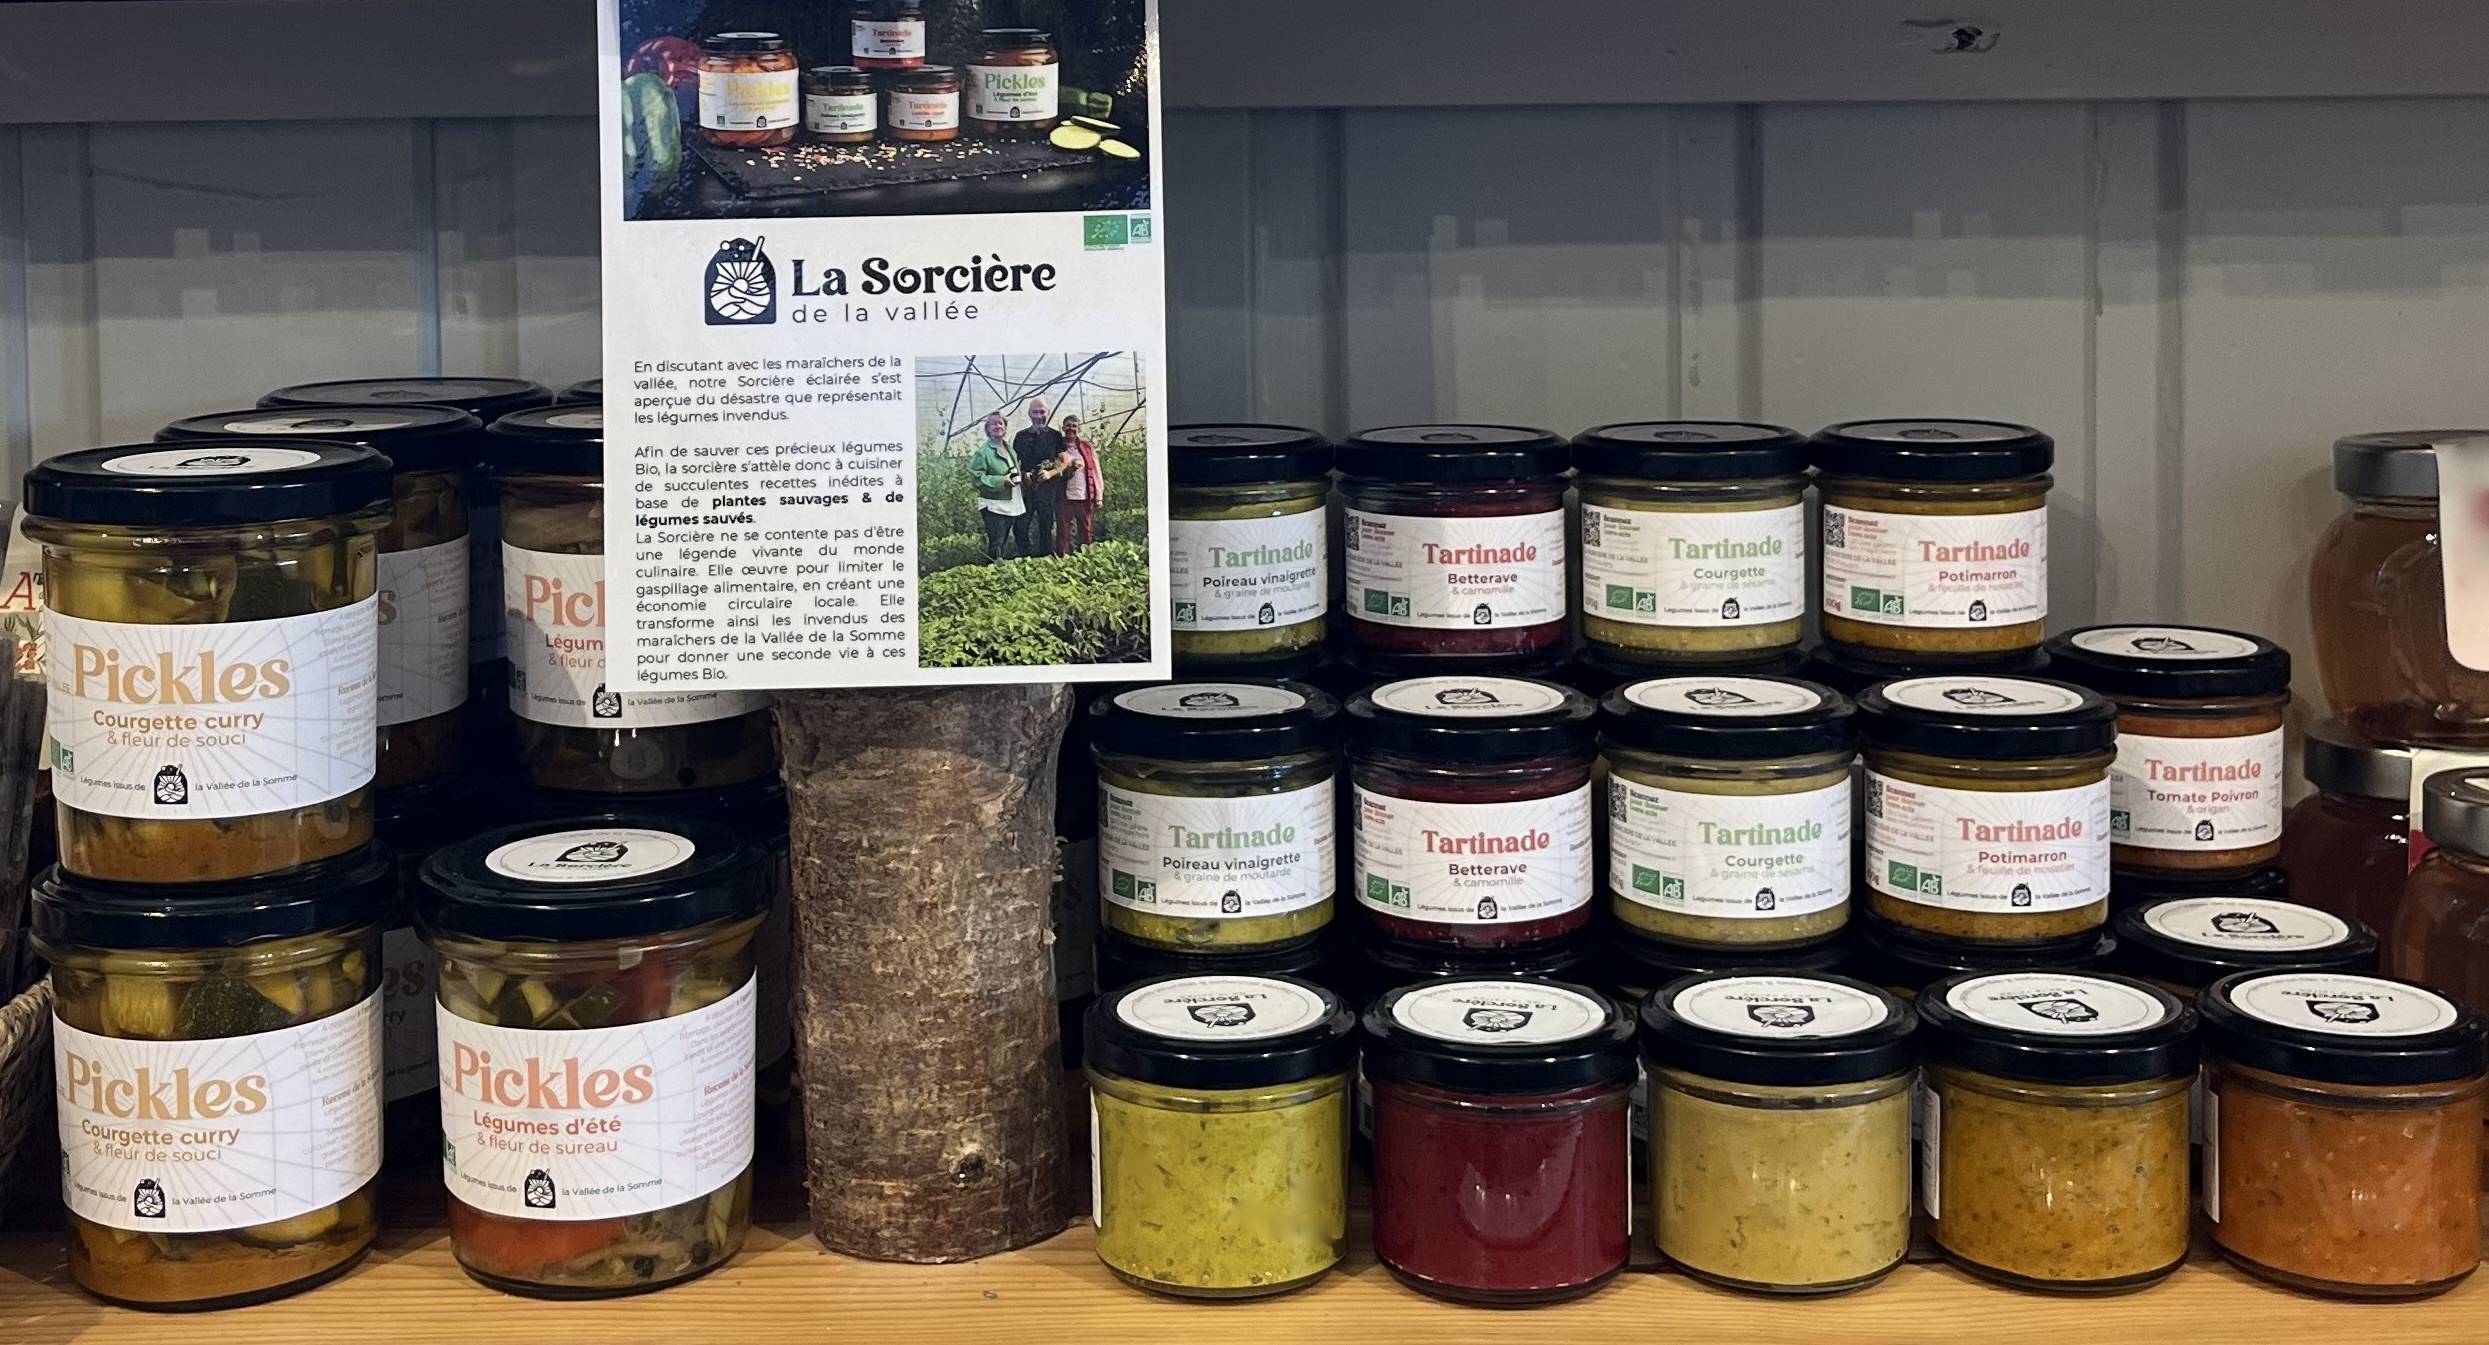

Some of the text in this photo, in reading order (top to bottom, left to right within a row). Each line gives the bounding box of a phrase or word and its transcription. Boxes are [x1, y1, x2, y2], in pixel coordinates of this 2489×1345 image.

[791, 253, 1057, 297] La Sorcière
[792, 300, 979, 323] de la vallée
[634, 356, 901, 373] En discutant avec les maraîchers de la
[634, 372, 901, 391] vallée, notre Sorcière éclairée s'est
[634, 389, 902, 409] aperçue du désastre que représentait
[635, 408, 789, 425] les légumes invendus.
[634, 441, 903, 458] Afin de sauver ces précieux légumes
[636, 458, 903, 476] Bio, la sorcière s'attèle donc à cuisiner
[635, 474, 903, 492] de succulentes recettes inédites à
[636, 491, 904, 510] base de plantes sauvages & de
[636, 511, 756, 529] légumes sauvés.
[636, 526, 904, 544] La Sorcière ne se contente pas d'être
[636, 543, 904, 562] une légende vivante du monde
[1208, 538, 1313, 568] Tartinade
[1422, 541, 1537, 565] Tartinade
[1669, 536, 1783, 560] Tartinade
[1918, 538, 2030, 562] Tartinade
[636, 560, 904, 578] culinaire. Elle œuvre pour limiter le
[1202, 567, 1316, 588] Poireau vinaigrette
[1448, 572, 1518, 584] Betterave
[1693, 566, 1766, 581] Courgette
[1939, 569, 2017, 583] Potimarron
[636, 578, 904, 598] gaspillage alimentaire, en créant une
[636, 594, 904, 612] économie circulaire locale. Elle
[636, 612, 905, 629] transforme ainsi les invendus des
[545, 632, 606, 655] Légum
[637, 630, 905, 647] maraîchers de la Vallée de la Somme
[560, 654, 593, 668] fleur
[637, 646, 905, 666] pour donner une seconde vie à ces
[73, 643, 290, 705] Pickles
[638, 668, 728, 684] légumes Bio.
[93, 709, 264, 734] Courgette curry
[107, 731, 246, 748] & fleur de souci
[2145, 758, 2262, 782] Tartinade
[195, 774, 298, 792] la Vallée de la Somme
[2147, 789, 2259, 803] Tomate Poivron
[1168, 822, 1296, 849] Tartinade
[1698, 819, 1823, 846] Tartinade
[1956, 816, 2083, 843] Tartinade
[1422, 829, 1550, 854] Tartinade
[1163, 852, 1301, 872] Poireau vinaigrette
[1724, 853, 1804, 869] Courgette
[1978, 849, 2068, 864] Potimarron
[1449, 862, 1527, 876] Betterave
[452, 1040, 655, 1110] Pickles
[65, 1051, 267, 1121] Pickles
[81, 1118, 240, 1146] Courgette curry
[473, 1109, 622, 1136] Légumes d'été
[93, 1142, 221, 1162] & fleur de souci
[477, 1133, 618, 1155] & fleur de sureau
